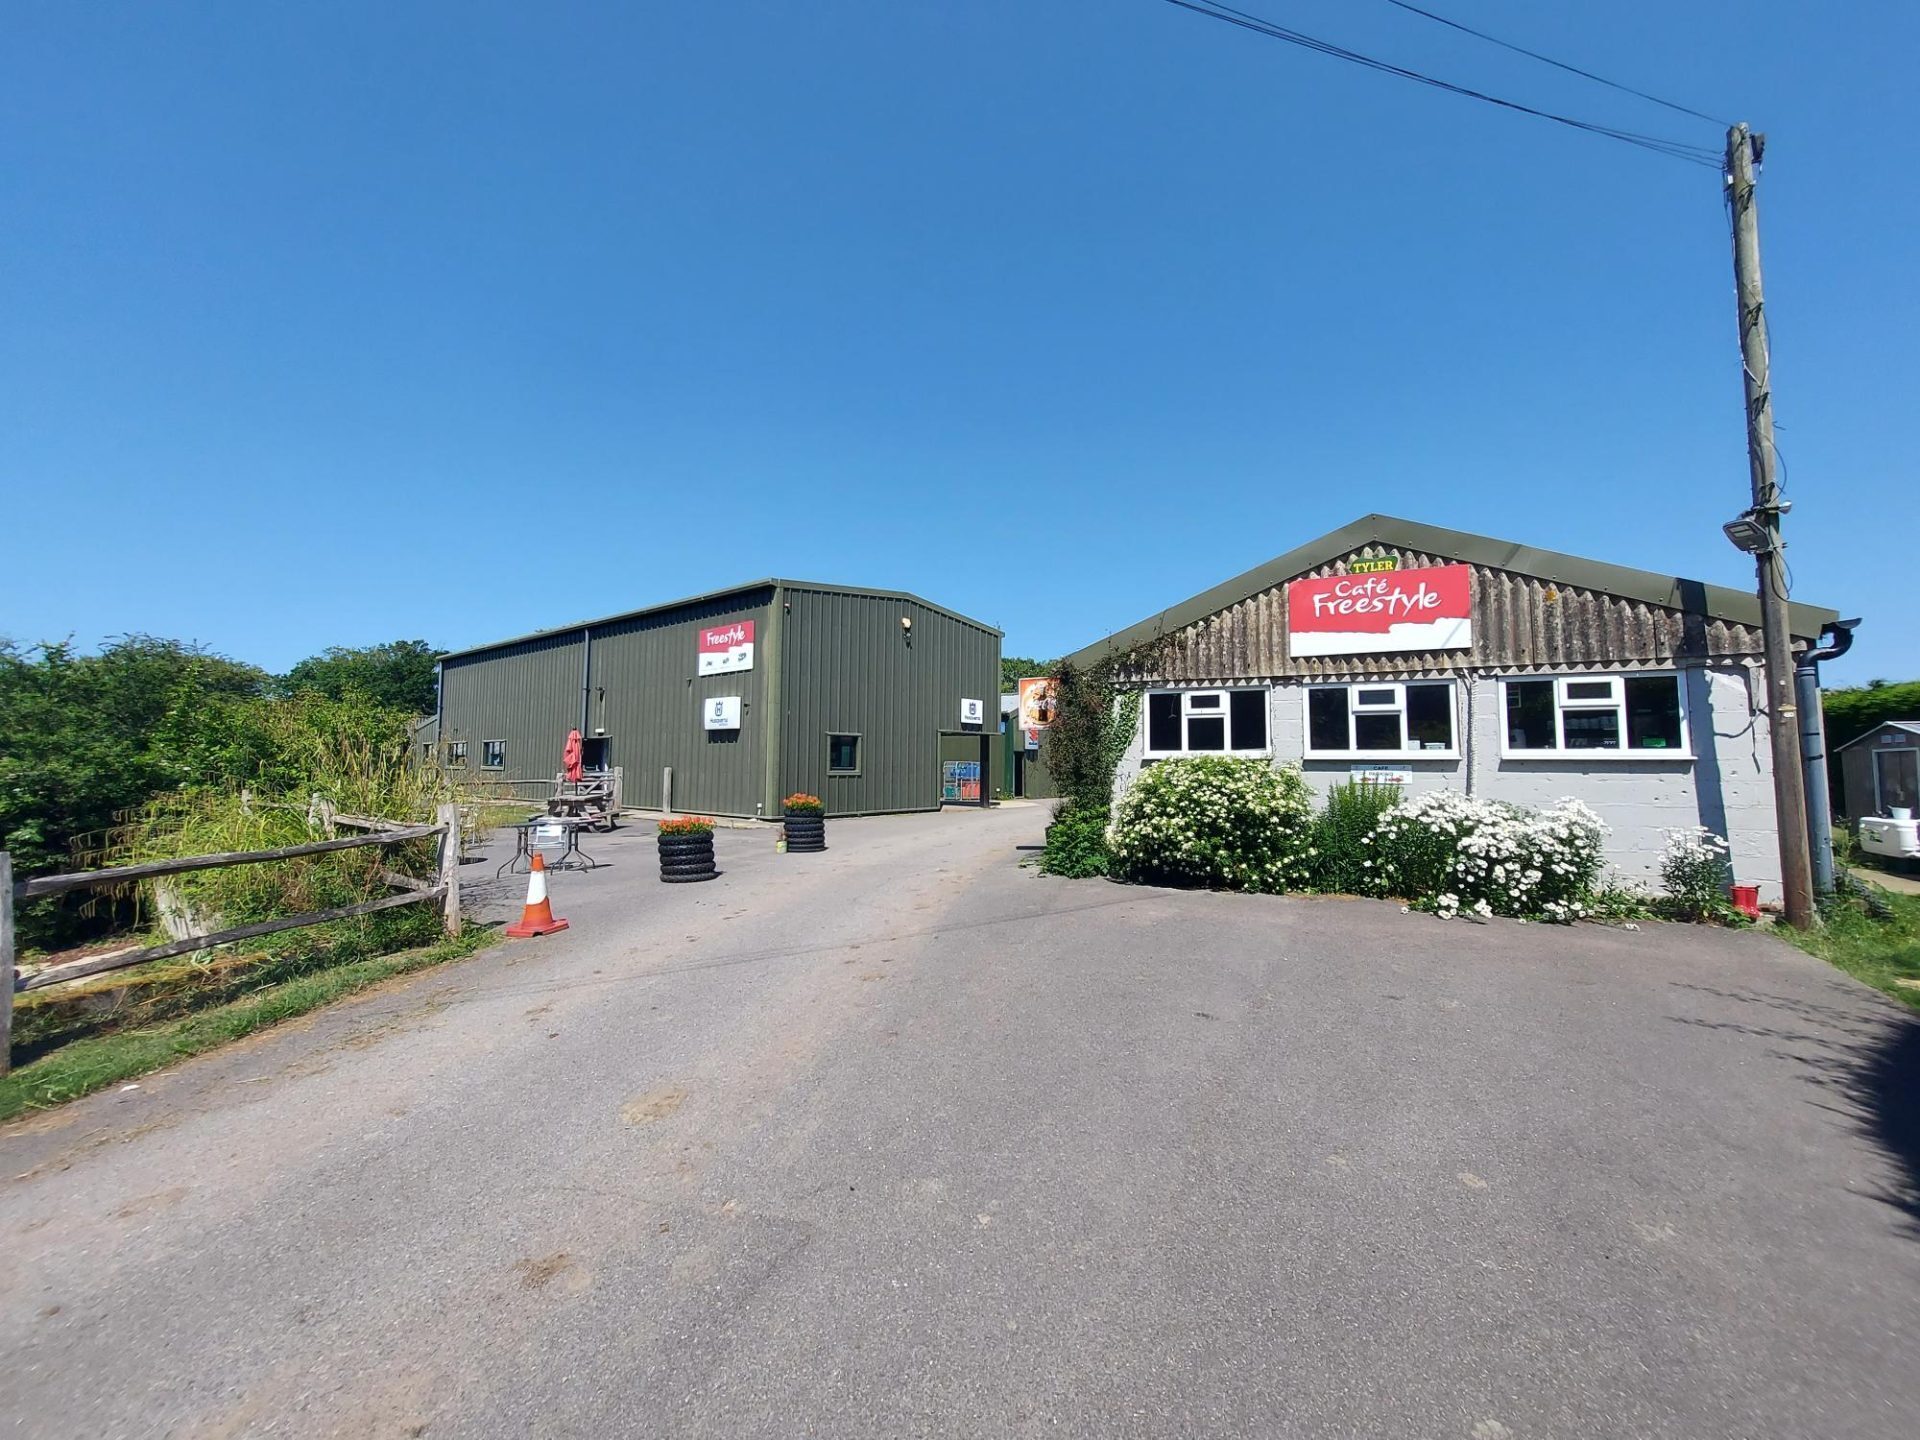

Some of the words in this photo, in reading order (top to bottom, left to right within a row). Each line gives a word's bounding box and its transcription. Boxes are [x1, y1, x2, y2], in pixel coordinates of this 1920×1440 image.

[1353, 560, 1394, 573] TYLER
[1335, 577, 1390, 597] Café
[1312, 582, 1442, 617] Freestyle
[706, 624, 746, 646] Freestyle
